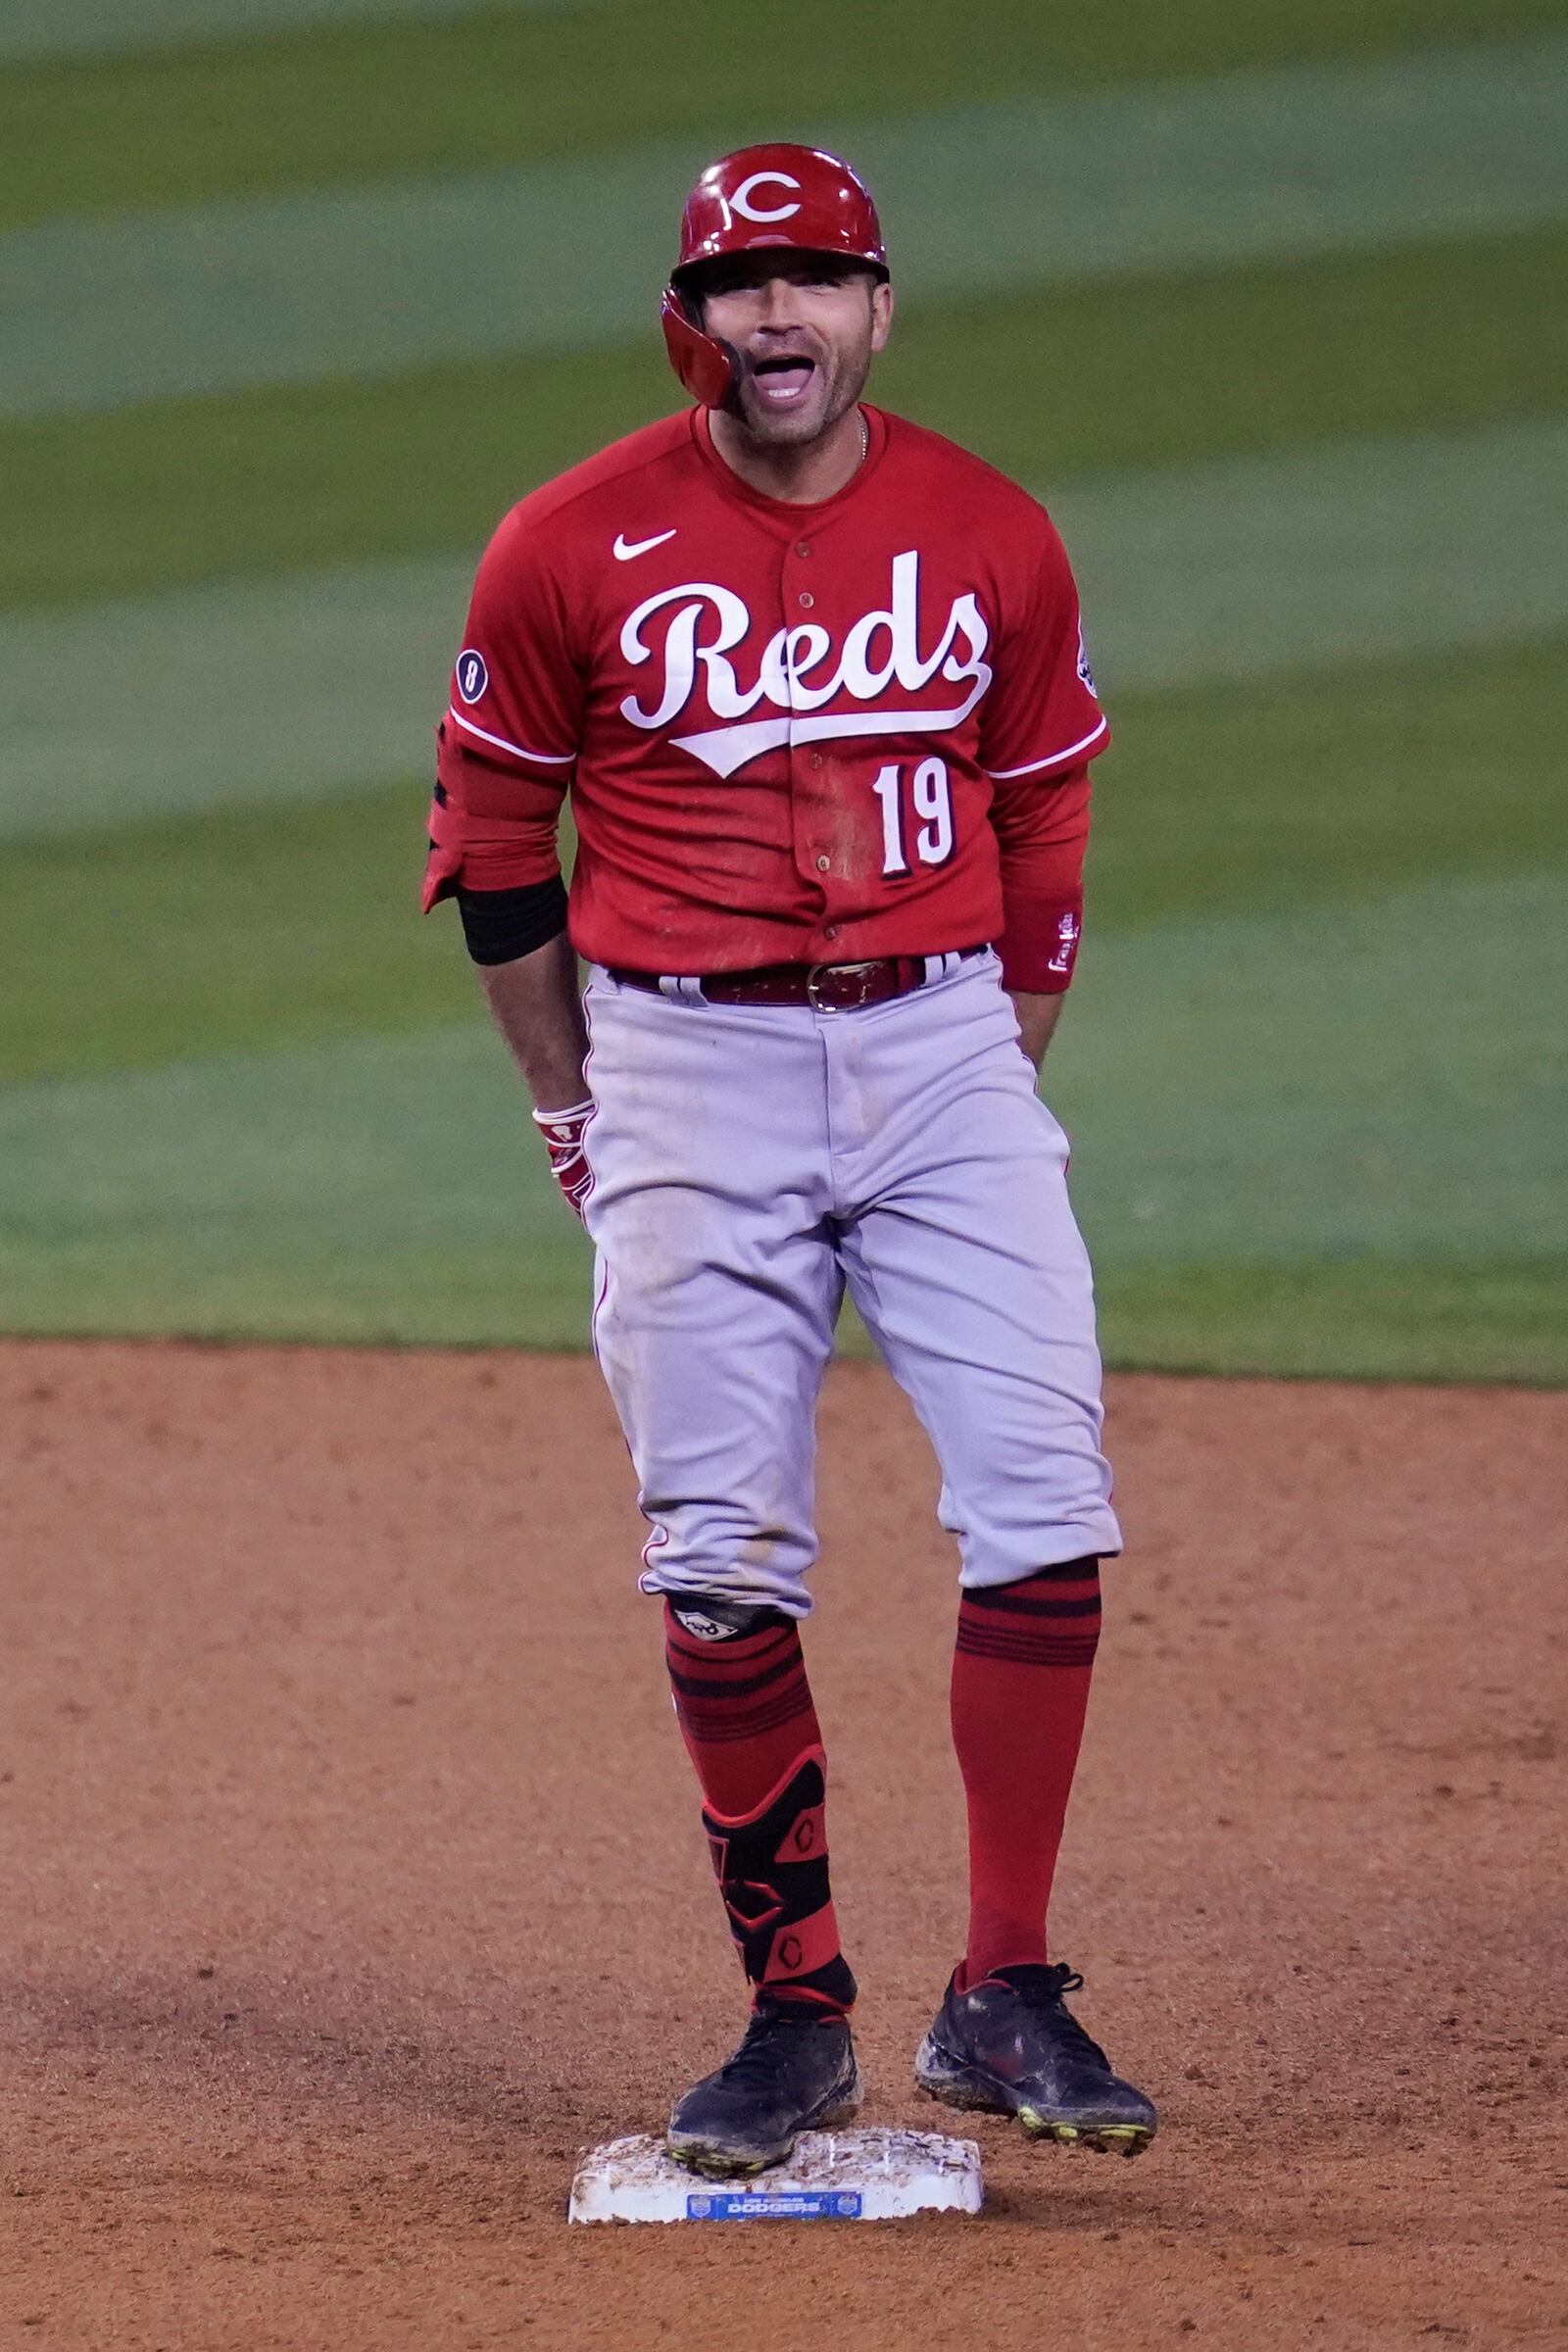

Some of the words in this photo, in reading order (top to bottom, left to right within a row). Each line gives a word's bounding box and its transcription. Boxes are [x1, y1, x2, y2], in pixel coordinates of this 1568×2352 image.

[729, 172, 802, 223] C
[620, 550, 992, 731] Reds
[465, 660, 478, 693] 8
[872, 757, 953, 874] 19
[728, 2202, 820, 2213] DODGERS
